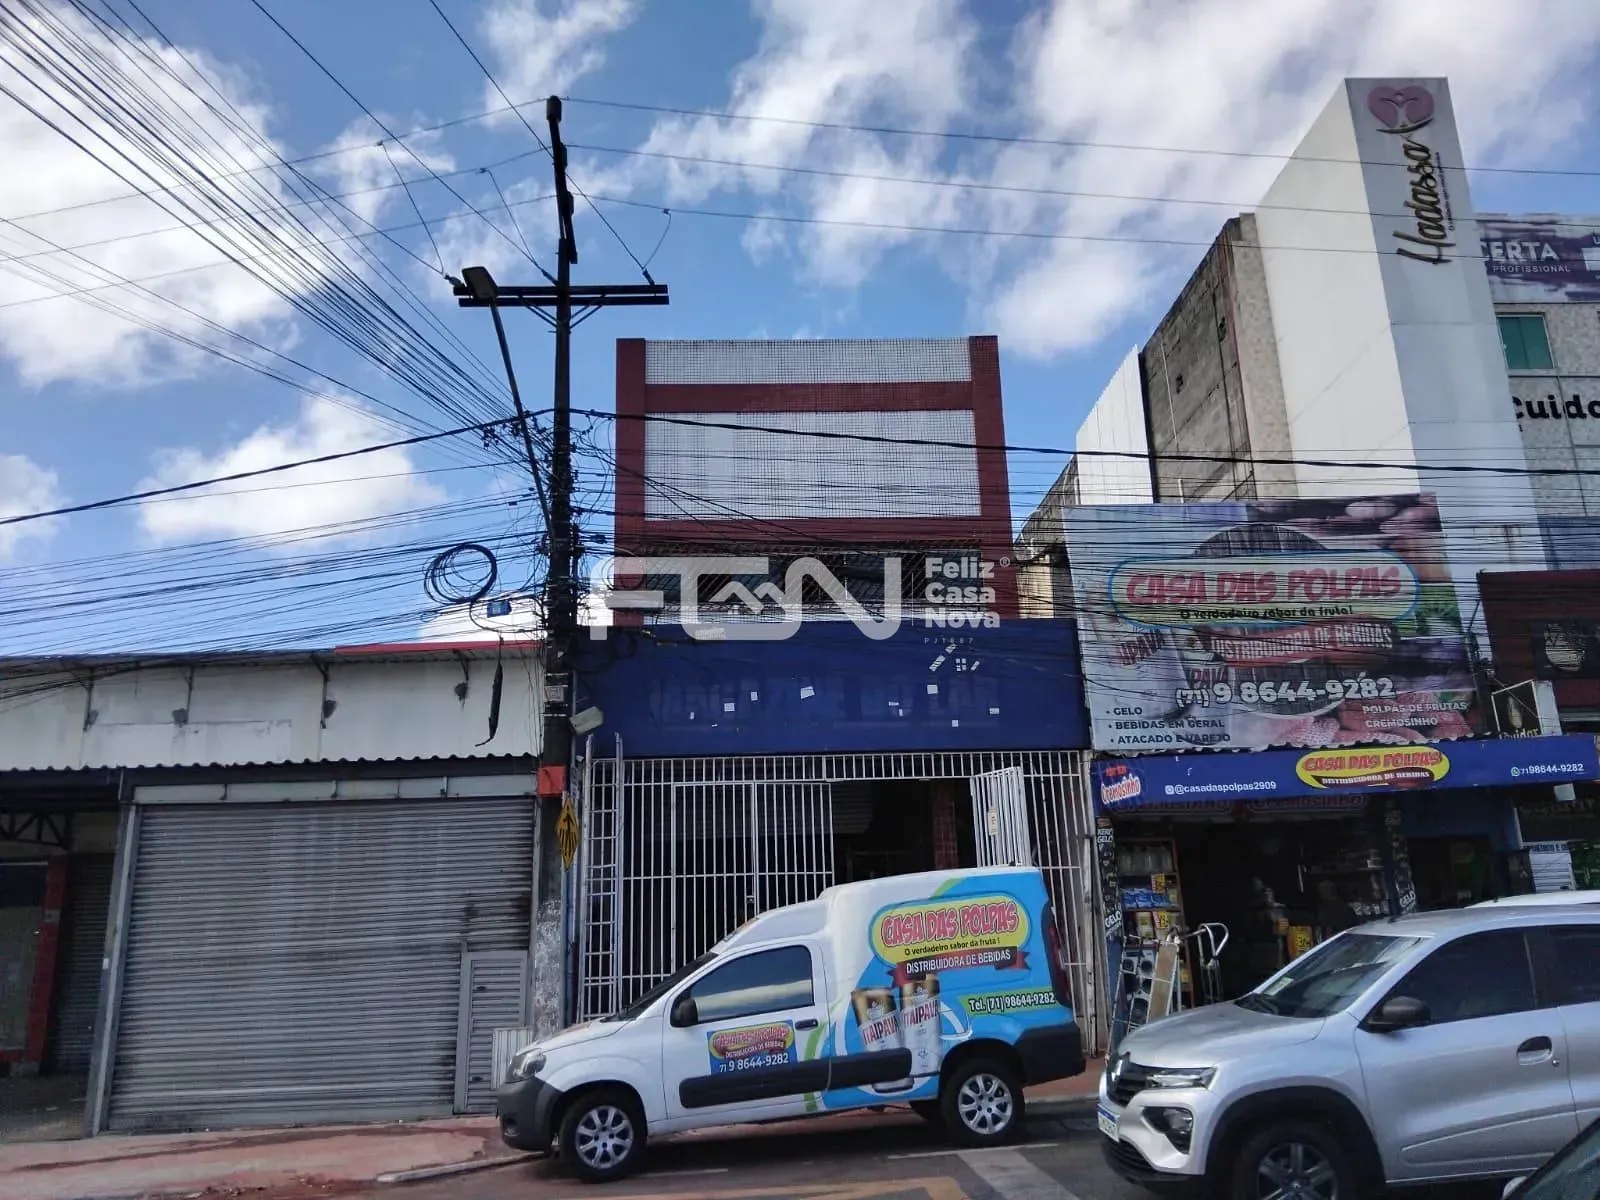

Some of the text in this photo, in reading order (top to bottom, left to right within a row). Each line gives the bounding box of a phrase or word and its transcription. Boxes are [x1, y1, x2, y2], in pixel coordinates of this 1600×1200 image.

[1392, 136, 1456, 265] Hadassa
[1492, 264, 1571, 273] PROFISSIONAL
[1126, 565, 1402, 606] CASA DAS POLPAS
[1175, 676, 1397, 708] (71) 9 8644-9282
[1113, 707, 1143, 716] GELO
[1362, 701, 1468, 715] POLPAS DE FRUTAS
[1115, 719, 1225, 730] BEBIDAS EM GERAL
[1365, 717, 1438, 728] CREMOSINHO
[1117, 734, 1173, 745] ATACADO
[1186, 733, 1231, 744] VAREJO
[1303, 752, 1442, 772] CASA DAS POLPAS
[1174, 781, 1277, 796] @casadaspolpas2909
[880, 900, 1020, 948] CASA DAS POLPAS
[1104, 910, 1123, 929] GELO
[911, 944, 949, 955] verdadeiro
[950, 940, 969, 950] sabor
[969, 939, 979, 947] da
[980, 938, 996, 946] fruta
[906, 948, 1011, 975] DISTRIBUIDORA DE BEBIDAS
[968, 992, 1056, 1014] Tel. (71) 98644-9282
[903, 999, 940, 1030] ITAIPAVA
[863, 1014, 898, 1046] ITAIPAVA
[728, 1060, 735, 1072] 9
[737, 1052, 789, 1071] 8644-9282
